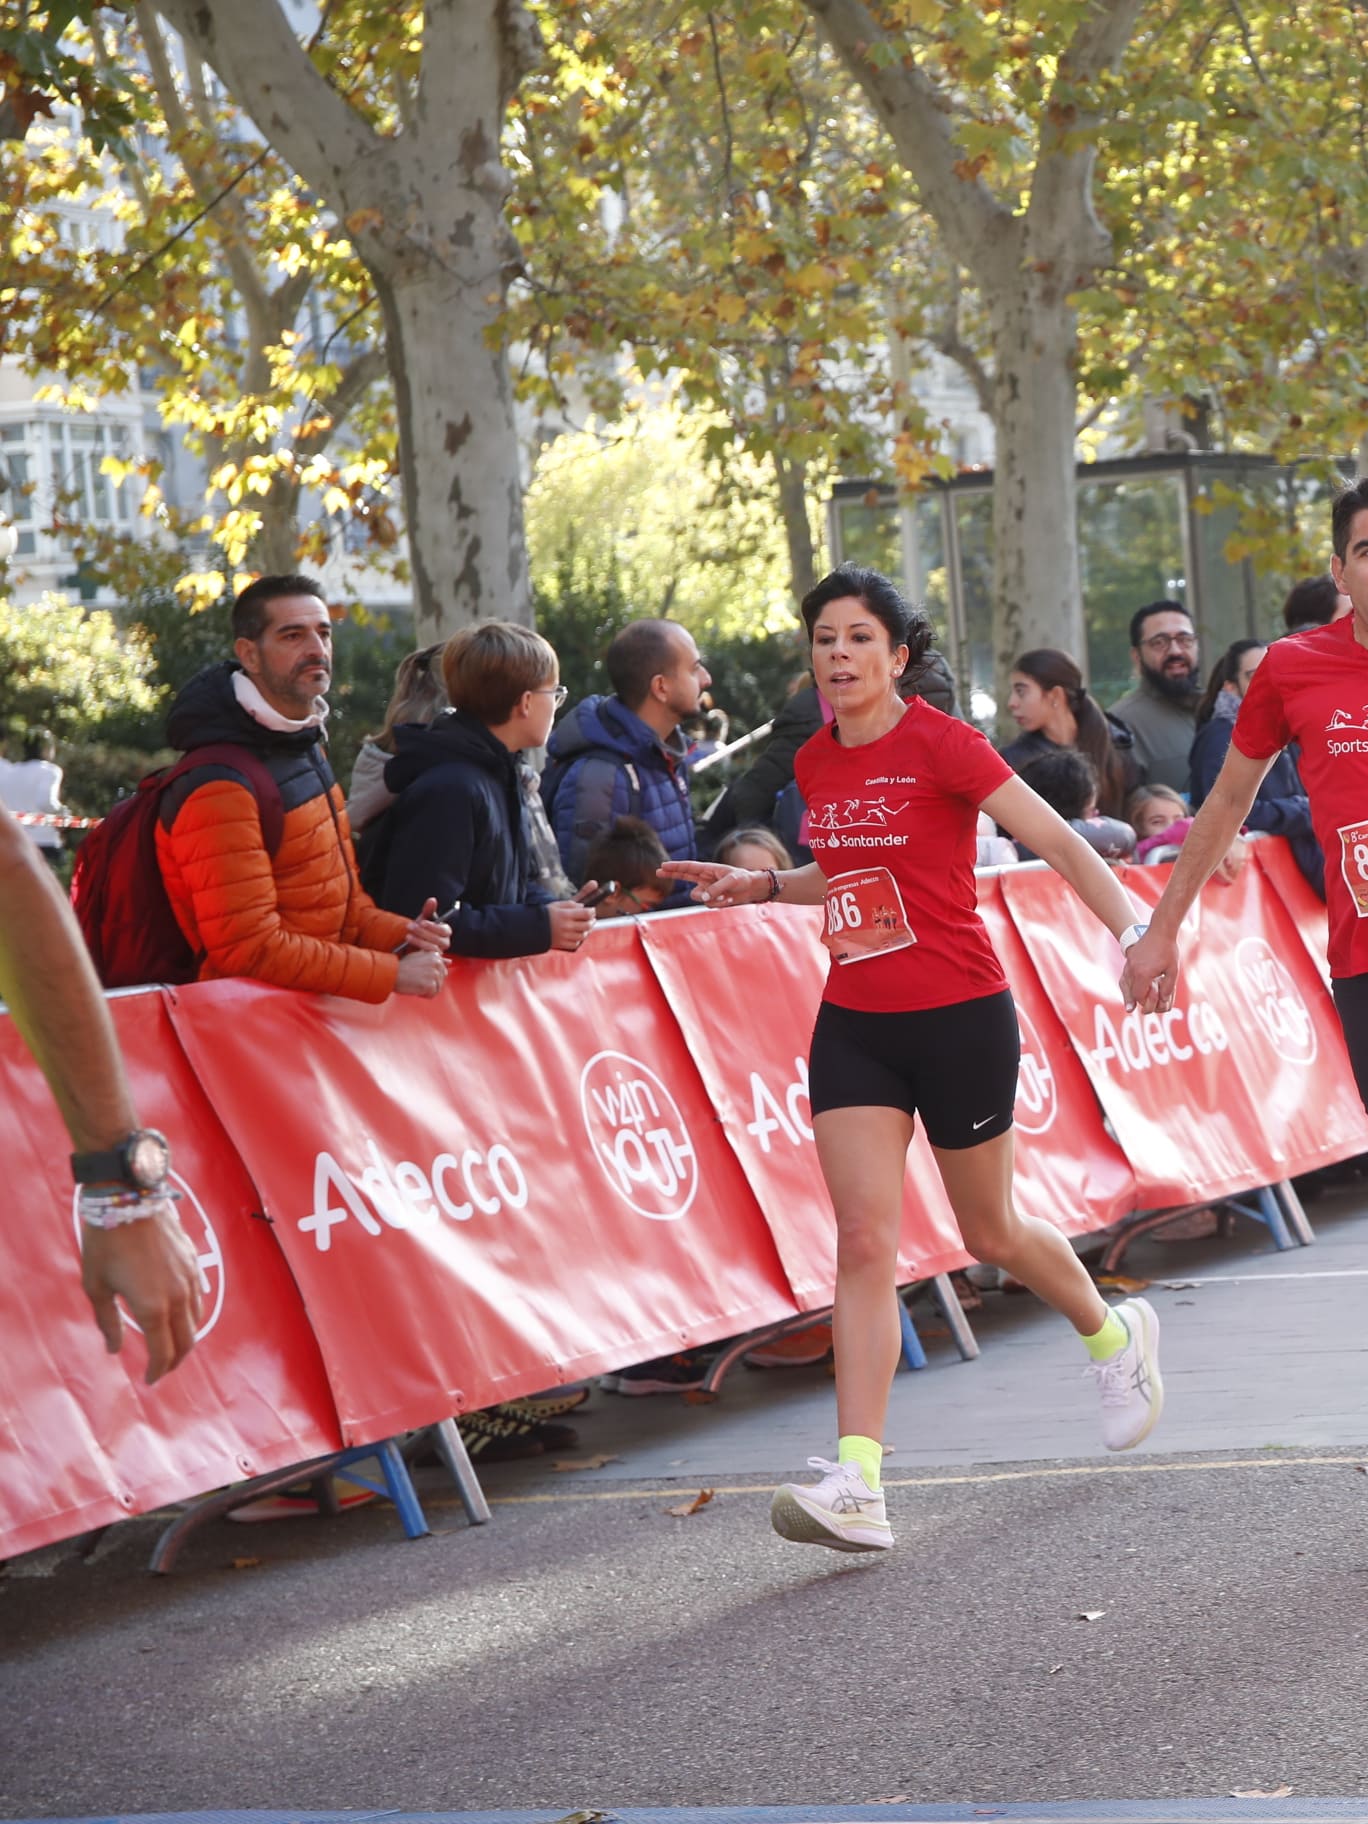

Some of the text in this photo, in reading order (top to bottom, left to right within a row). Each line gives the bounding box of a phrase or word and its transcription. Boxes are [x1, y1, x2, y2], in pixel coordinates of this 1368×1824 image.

[889, 777, 895, 785] y
[841, 833, 909, 848] Santander
[1091, 1001, 1229, 1076] Adecco
[296, 1139, 529, 1252] Adecco
